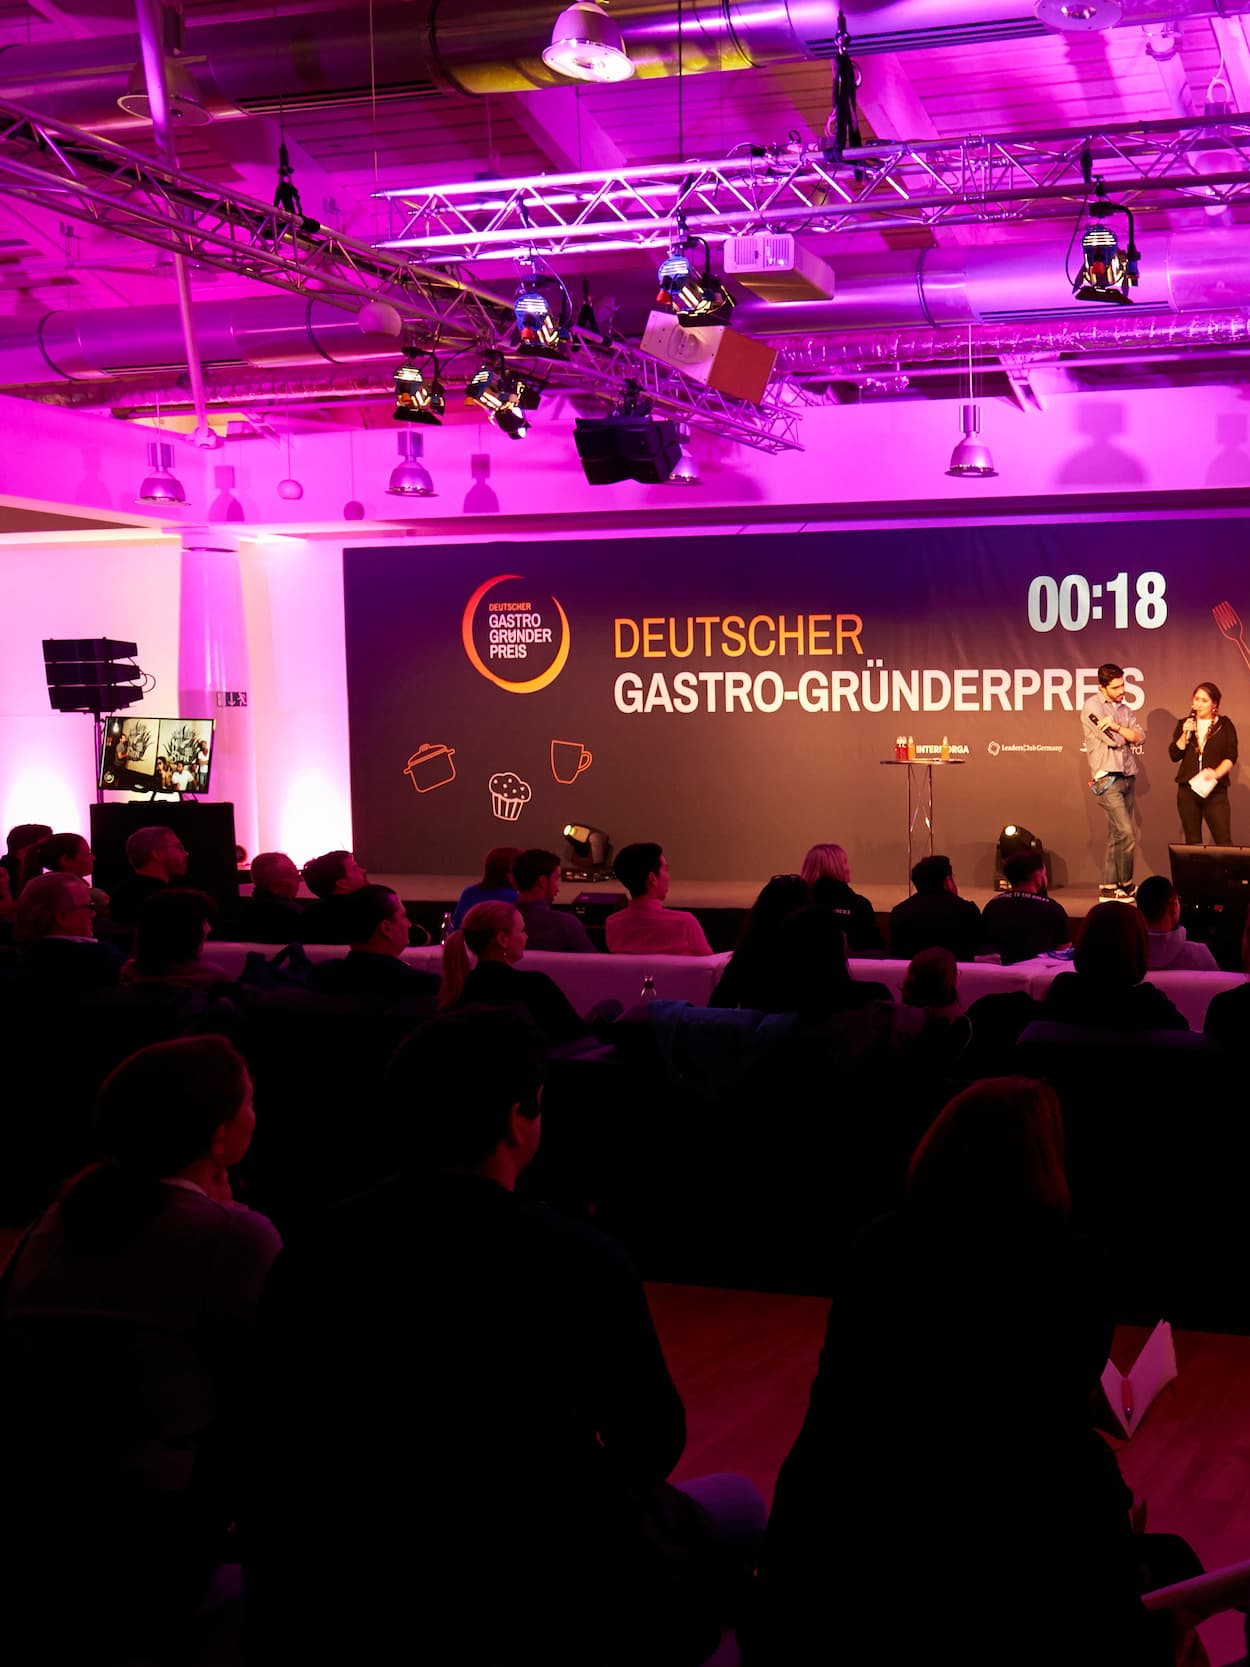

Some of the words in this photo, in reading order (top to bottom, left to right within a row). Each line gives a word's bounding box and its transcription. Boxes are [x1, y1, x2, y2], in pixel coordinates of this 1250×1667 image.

[488, 602, 531, 612] DEUTSCHER
[1027, 571, 1168, 632] 00:18
[489, 613, 541, 628] GASTRO
[614, 614, 864, 658] DEUTSCHER
[489, 644, 527, 659] PREIS
[614, 659, 1145, 713] GASTRO-GRÜNDERPRES
